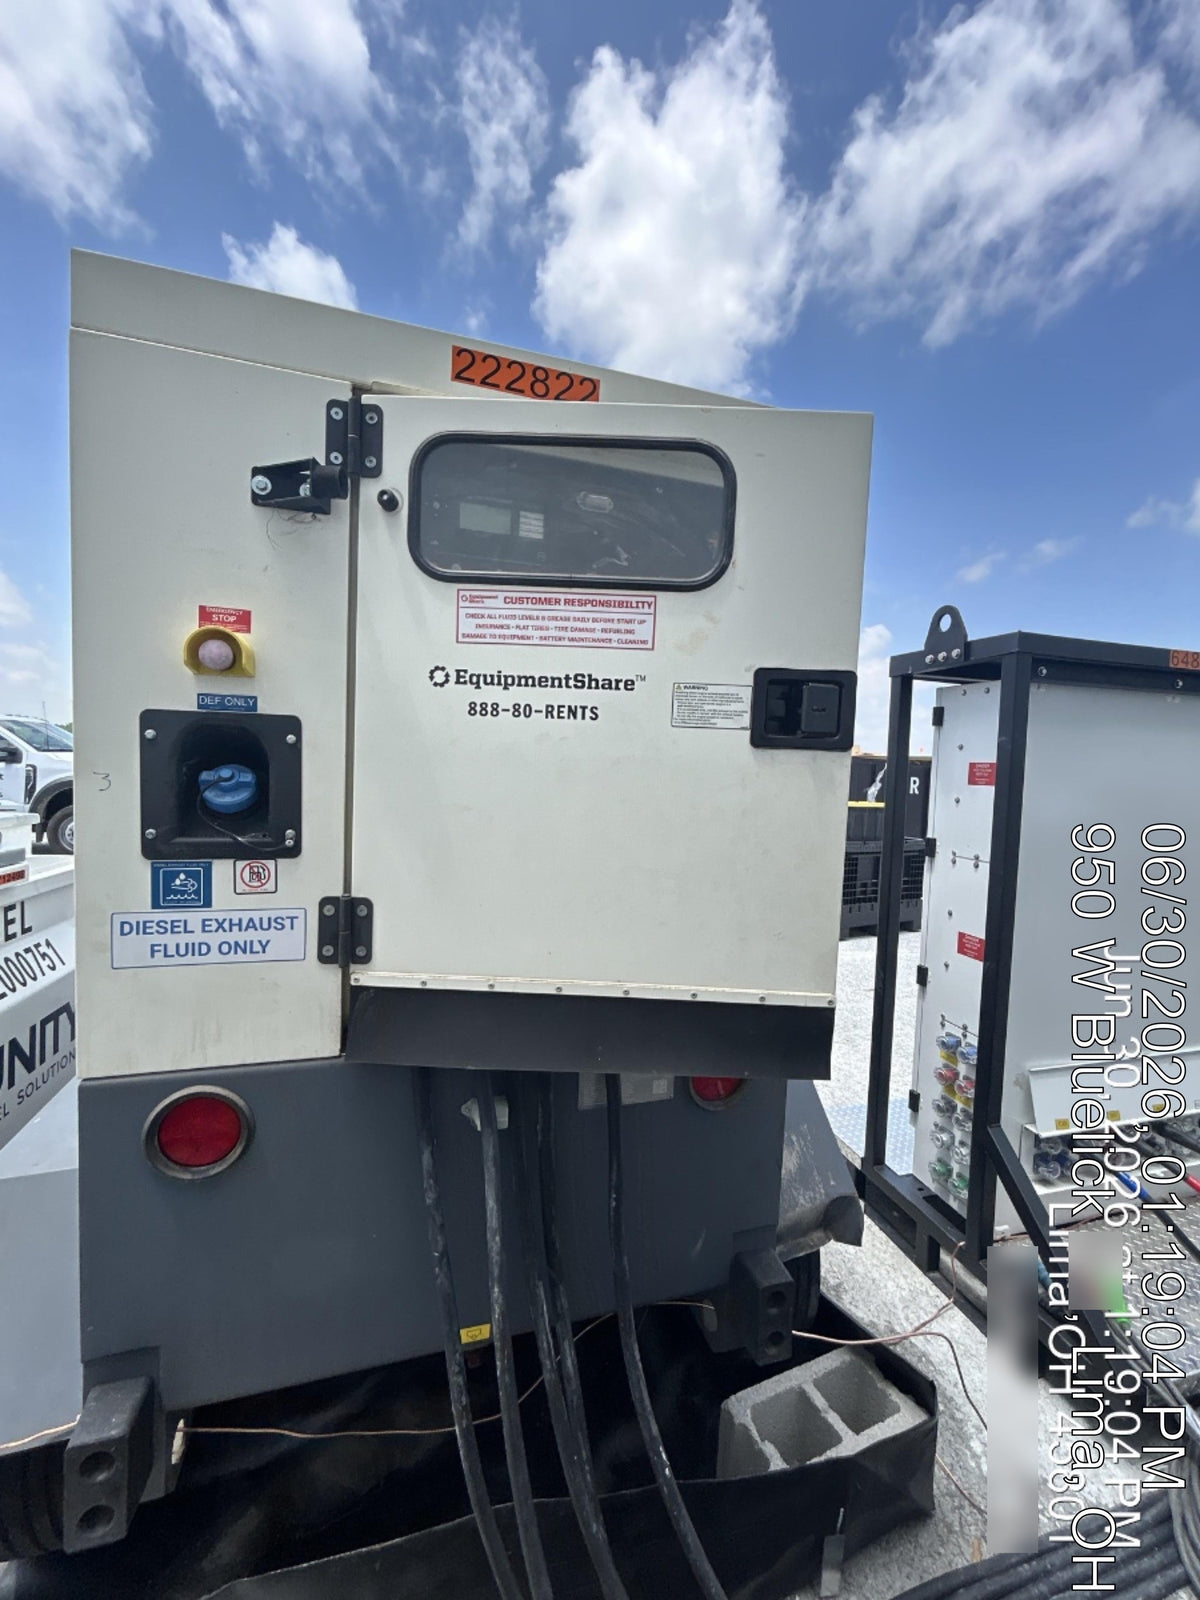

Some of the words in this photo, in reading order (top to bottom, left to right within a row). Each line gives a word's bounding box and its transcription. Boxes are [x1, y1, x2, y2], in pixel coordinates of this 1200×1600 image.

[454, 347, 597, 401] 222822
[503, 595, 562, 607] CUSTOMER
[563, 597, 654, 610] RESPONSIBILITY
[211, 613, 237, 623] STOP
[199, 695, 222, 705] DEF
[224, 696, 256, 707] ONLY
[467, 700, 600, 722] 888-80-RENTS
[119, 919, 195, 937] DIESEL
[200, 915, 299, 934] EXHAUST
[150, 941, 211, 959] FLUID
[217, 938, 271, 956] ONLY
[0, 937, 66, 1001] 000751
